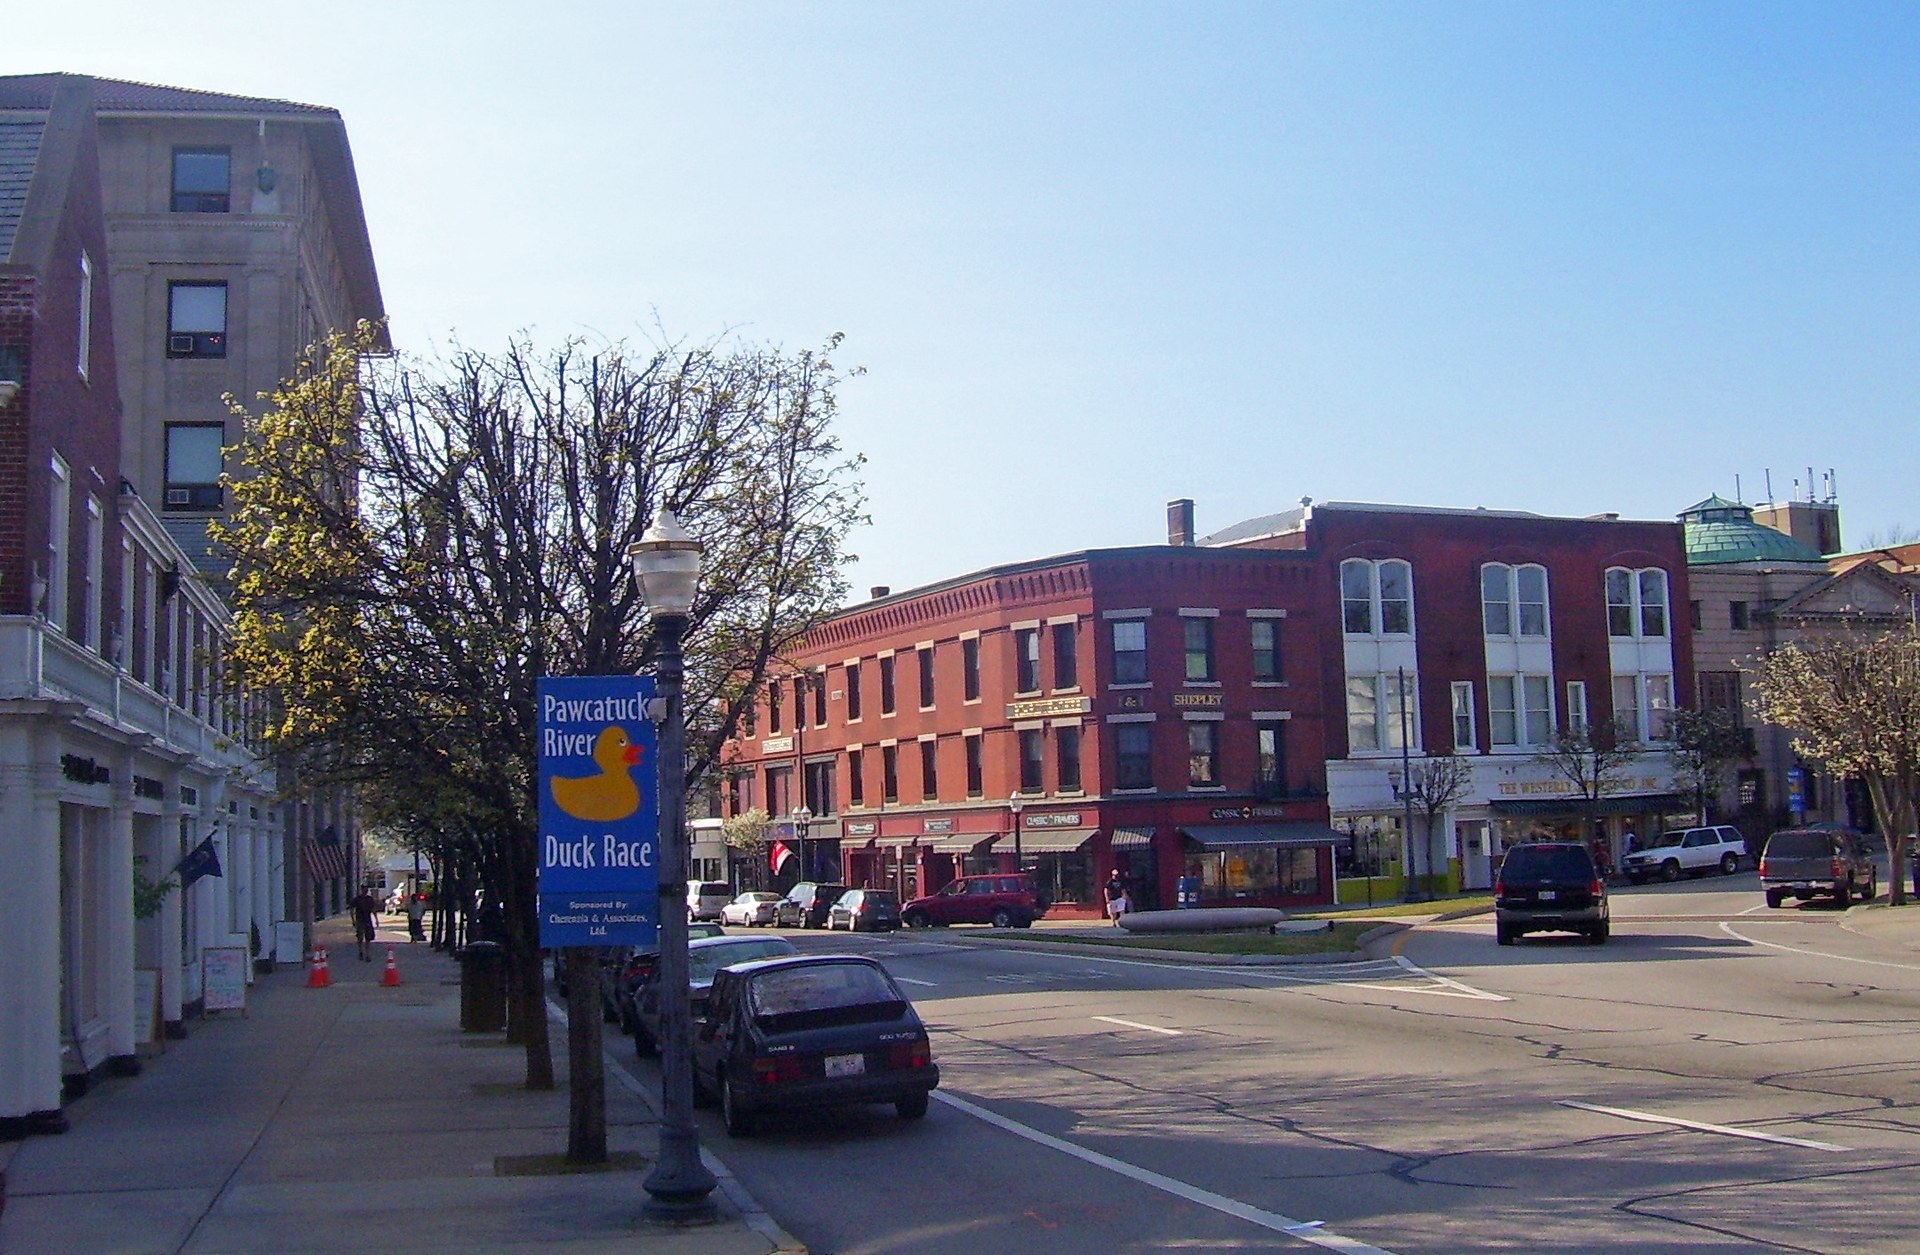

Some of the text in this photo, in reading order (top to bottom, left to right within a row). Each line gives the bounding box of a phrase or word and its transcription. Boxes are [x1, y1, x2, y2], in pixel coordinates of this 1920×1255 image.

[544, 691, 651, 723] Pawcatuck
[1125, 694, 1223, 707] & SHEPLEY
[544, 728, 597, 757] River
[545, 834, 652, 869] Duck Race
[569, 901, 613, 909] Sponsored
[591, 914, 600, 923] &
